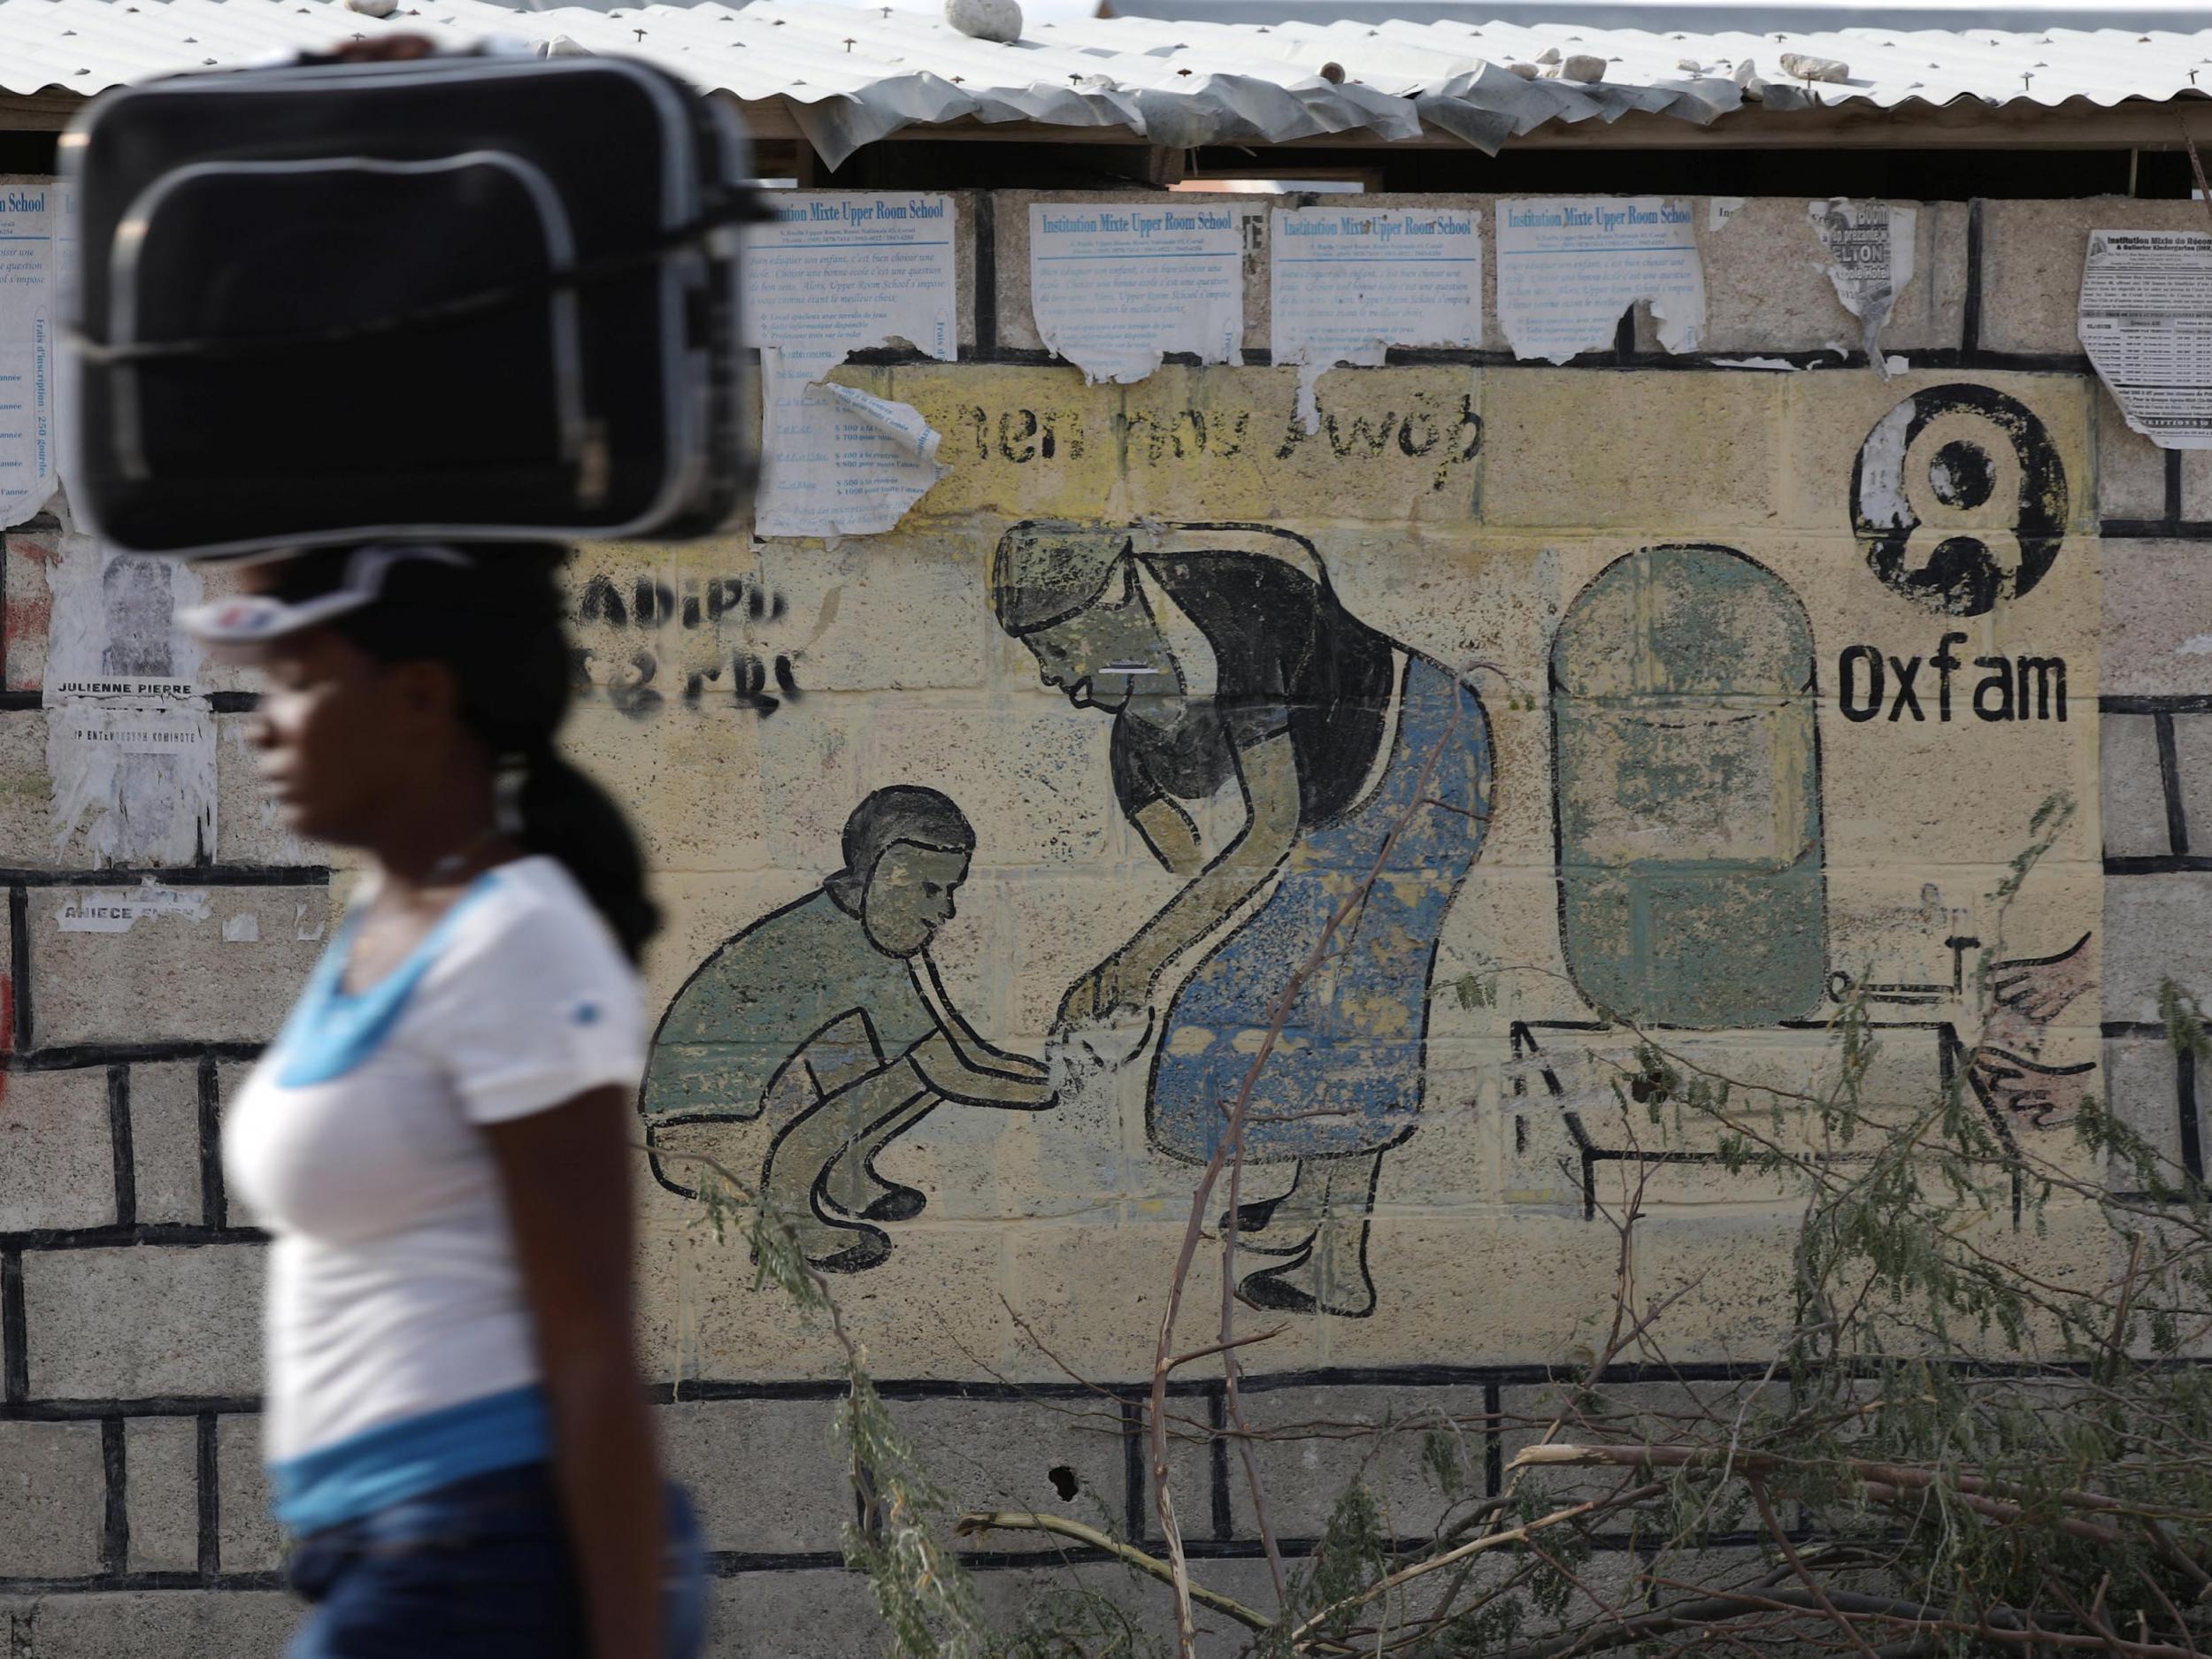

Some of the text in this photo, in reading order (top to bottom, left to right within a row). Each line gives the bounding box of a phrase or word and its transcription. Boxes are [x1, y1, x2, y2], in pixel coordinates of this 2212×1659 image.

[8, 191, 46, 213] School
[809, 202, 840, 221] Mixte
[841, 200, 873, 227] Upper
[876, 201, 908, 219] Room
[909, 198, 944, 219] School
[1041, 210, 1233, 238] Institution Mixte Upper Room School
[1282, 216, 1338, 235] Institution
[1339, 216, 1371, 235] Mixt
[1371, 216, 1402, 242] Upper
[1404, 216, 1436, 235] Room
[1507, 204, 1692, 232] Institution Mixte Upper Room Schoo
[6, 262, 42, 273] question
[824, 268, 847, 277] bonne
[11, 275, 46, 287] s'impose
[35, 319, 48, 479] Frais d'inscription 250 gourdes
[58, 682, 192, 695] JULIENNE PIERRE
[1839, 631, 2069, 723] Oxfam
